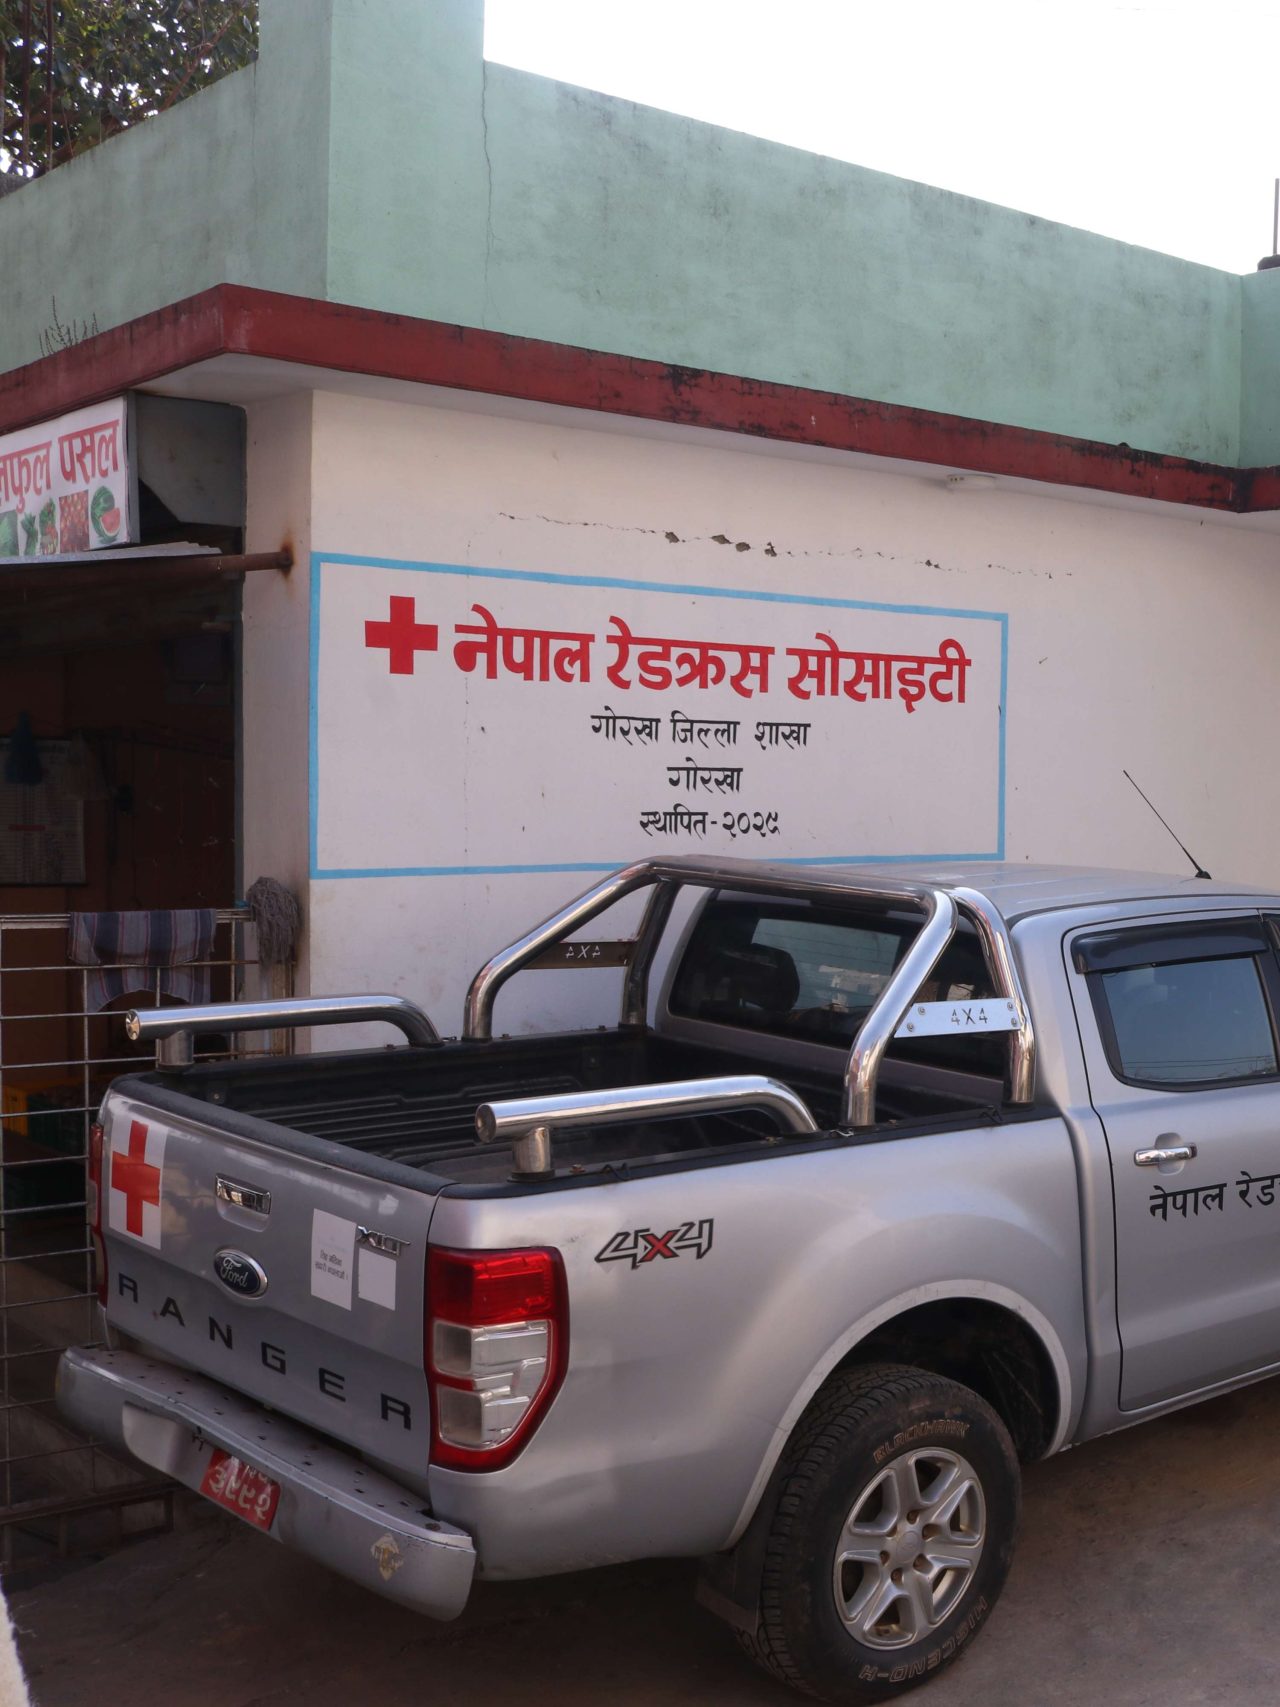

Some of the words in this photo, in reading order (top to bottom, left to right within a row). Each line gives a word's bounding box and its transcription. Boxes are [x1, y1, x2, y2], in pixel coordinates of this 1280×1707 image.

[58, 419, 120, 484] पसल
[453, 604, 595, 683] नेपाल
[606, 616, 775, 698] रेडक्रस
[786, 633, 972, 713] सोसाइटी
[591, 706, 661, 746] गोरखा
[670, 710, 741, 749] जिल्ला
[755, 722, 811, 751] शाखा
[666, 757, 743, 794] गोरखा
[1150, 1184, 1227, 1222] नेपाल
[219, 1257, 250, 1288] Ford
[118, 1273, 412, 1430] RANGER
